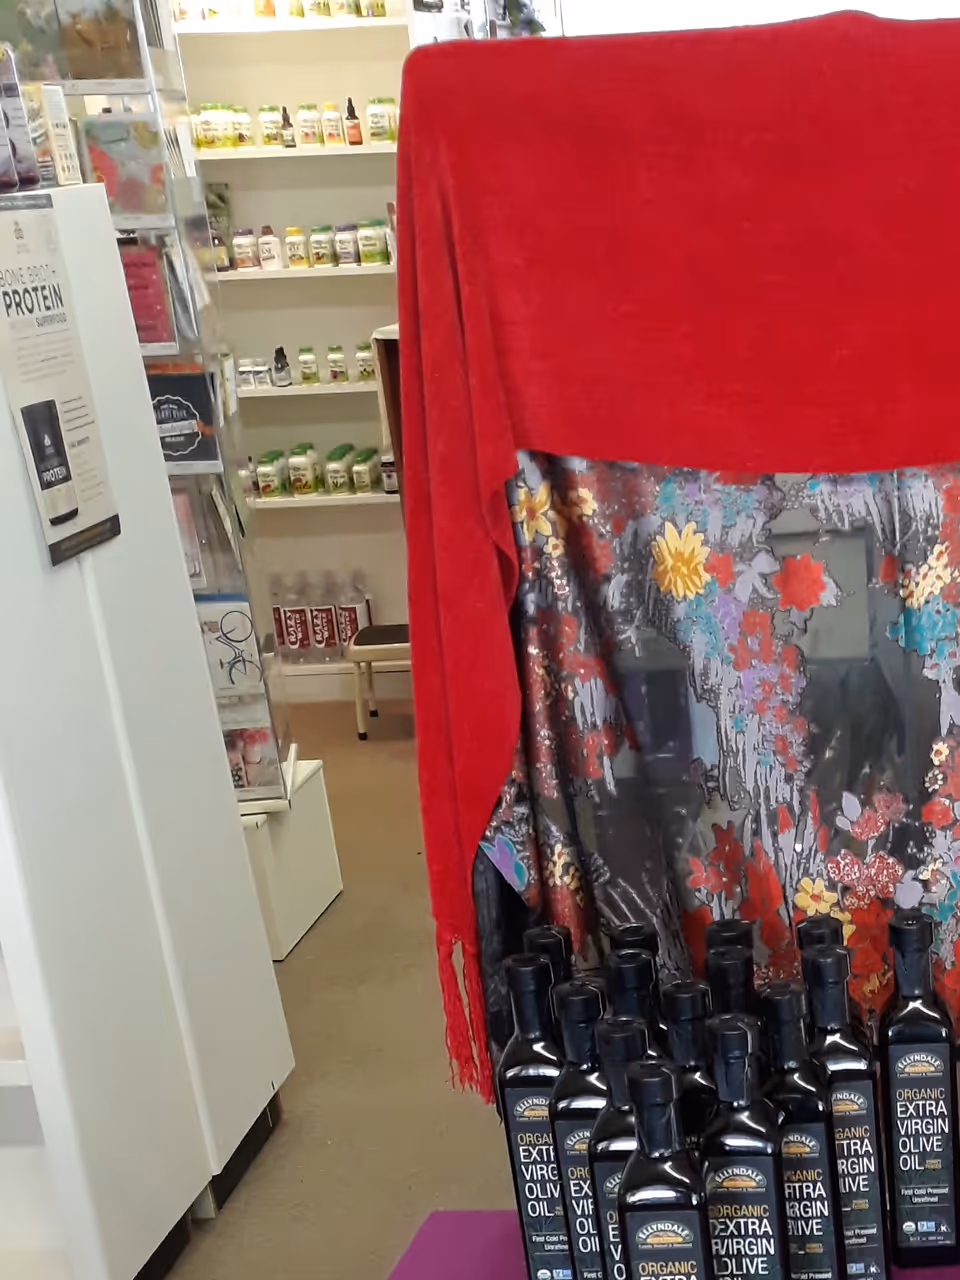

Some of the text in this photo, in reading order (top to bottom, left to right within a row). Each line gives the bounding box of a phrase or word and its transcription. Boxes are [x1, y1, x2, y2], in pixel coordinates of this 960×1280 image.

[2, 283, 64, 317] PROTEIN
[898, 1054, 941, 1070] ELLYNDALE
[896, 1088, 945, 1100] ORGANIC
[897, 1100, 948, 1117] EXTRA
[897, 1118, 949, 1135] VIRGIN
[518, 1133, 552, 1144] ORGA
[567, 1131, 591, 1145] ELLYN
[899, 1136, 943, 1153] OLIVE
[900, 1155, 924, 1170] OIL
[521, 1164, 558, 1180] VIRG
[715, 1168, 763, 1183] ELLYNDALE
[525, 1182, 560, 1199] OLIV
[527, 1200, 554, 1217] OIL
[639, 1222, 690, 1239] ELLYNDALE
[639, 1261, 697, 1275] ORGANIC
